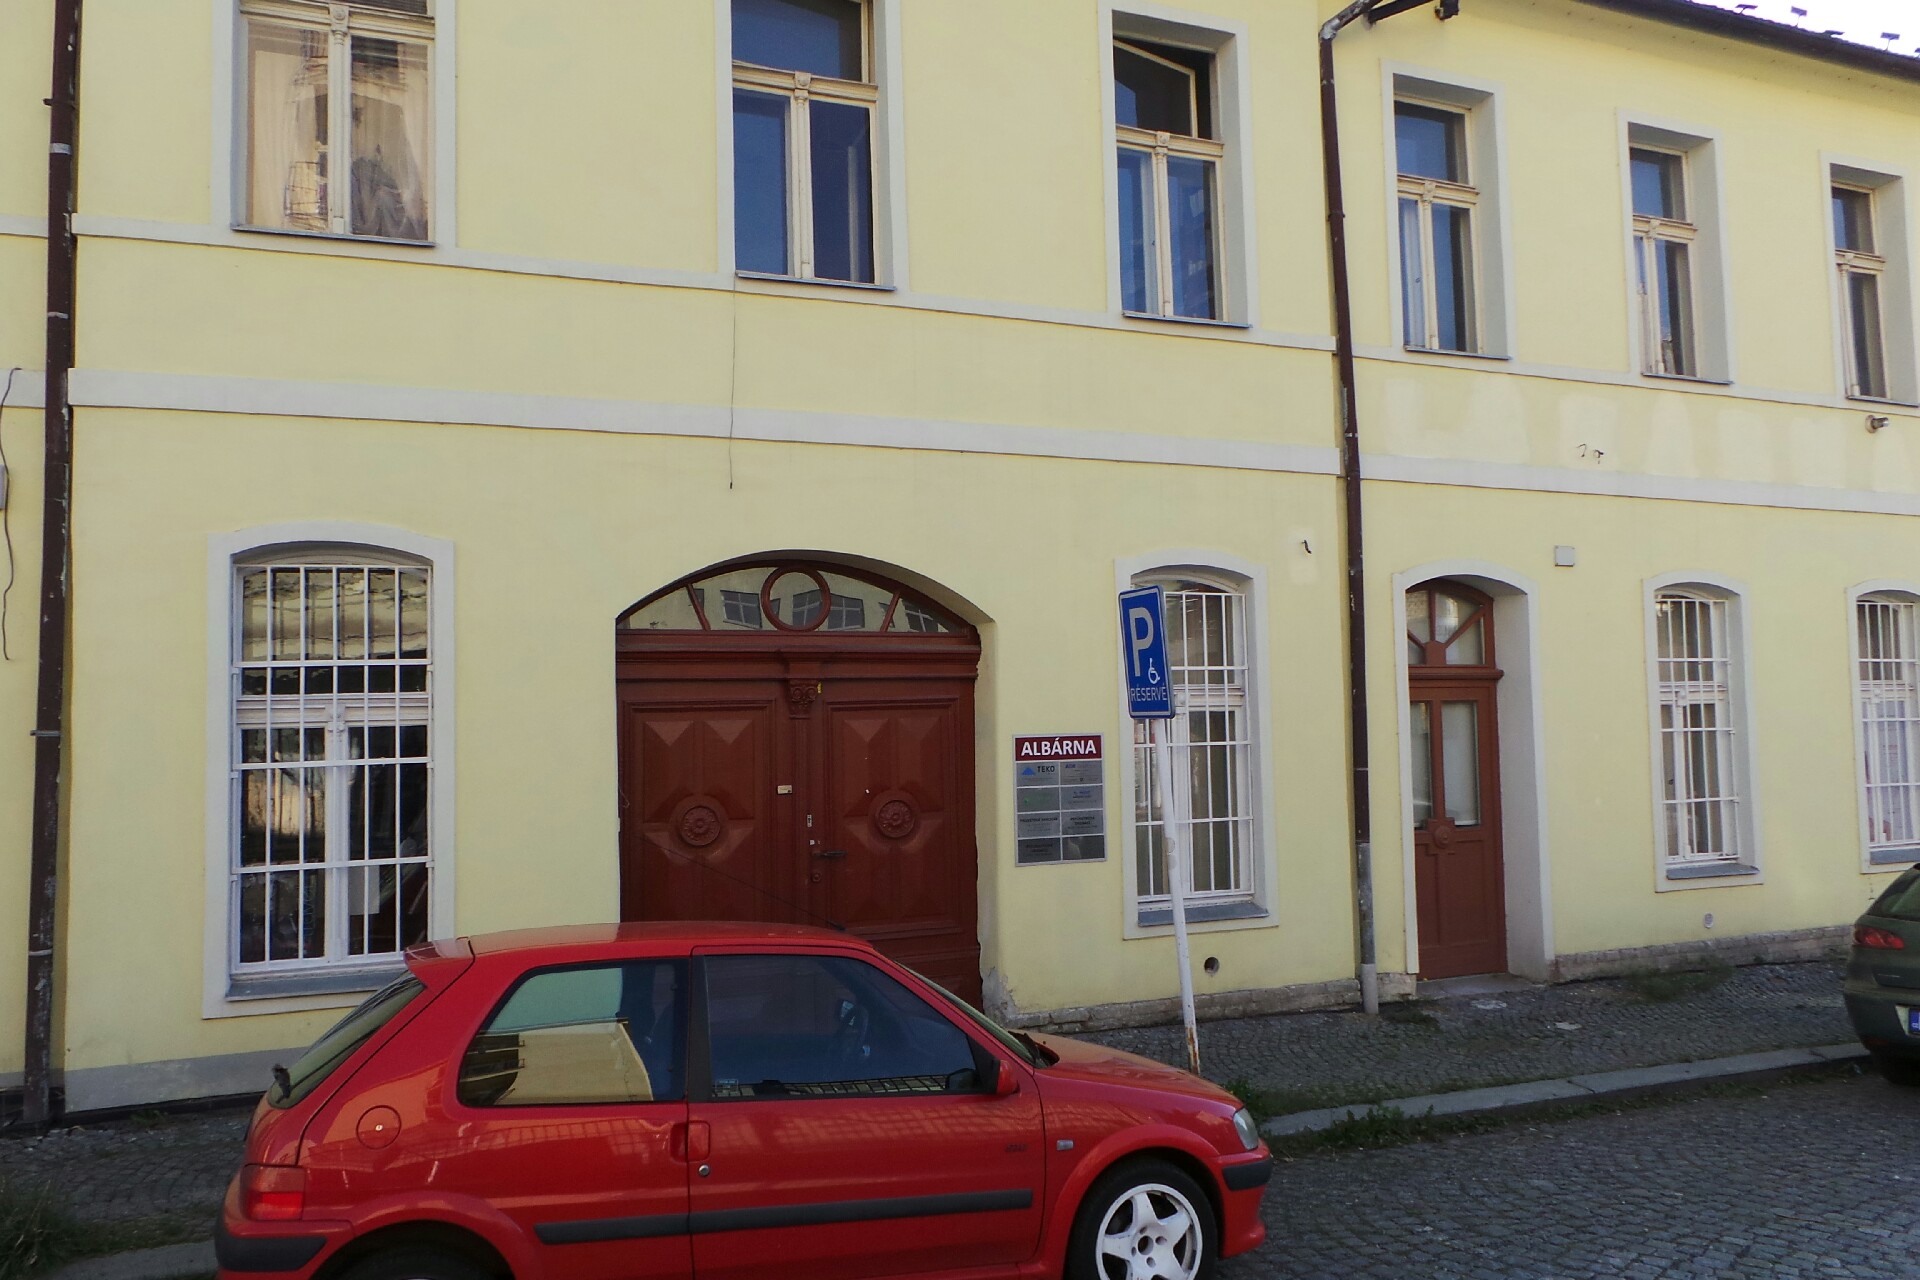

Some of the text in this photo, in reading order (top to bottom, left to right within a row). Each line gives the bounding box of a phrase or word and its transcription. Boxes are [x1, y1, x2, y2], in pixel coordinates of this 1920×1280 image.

[1129, 607, 1154, 677] P
[1130, 683, 1167, 702] RÉSERVÉ
[1021, 738, 1096, 756] ALBÁRNA
[1037, 765, 1055, 773] TEKO
